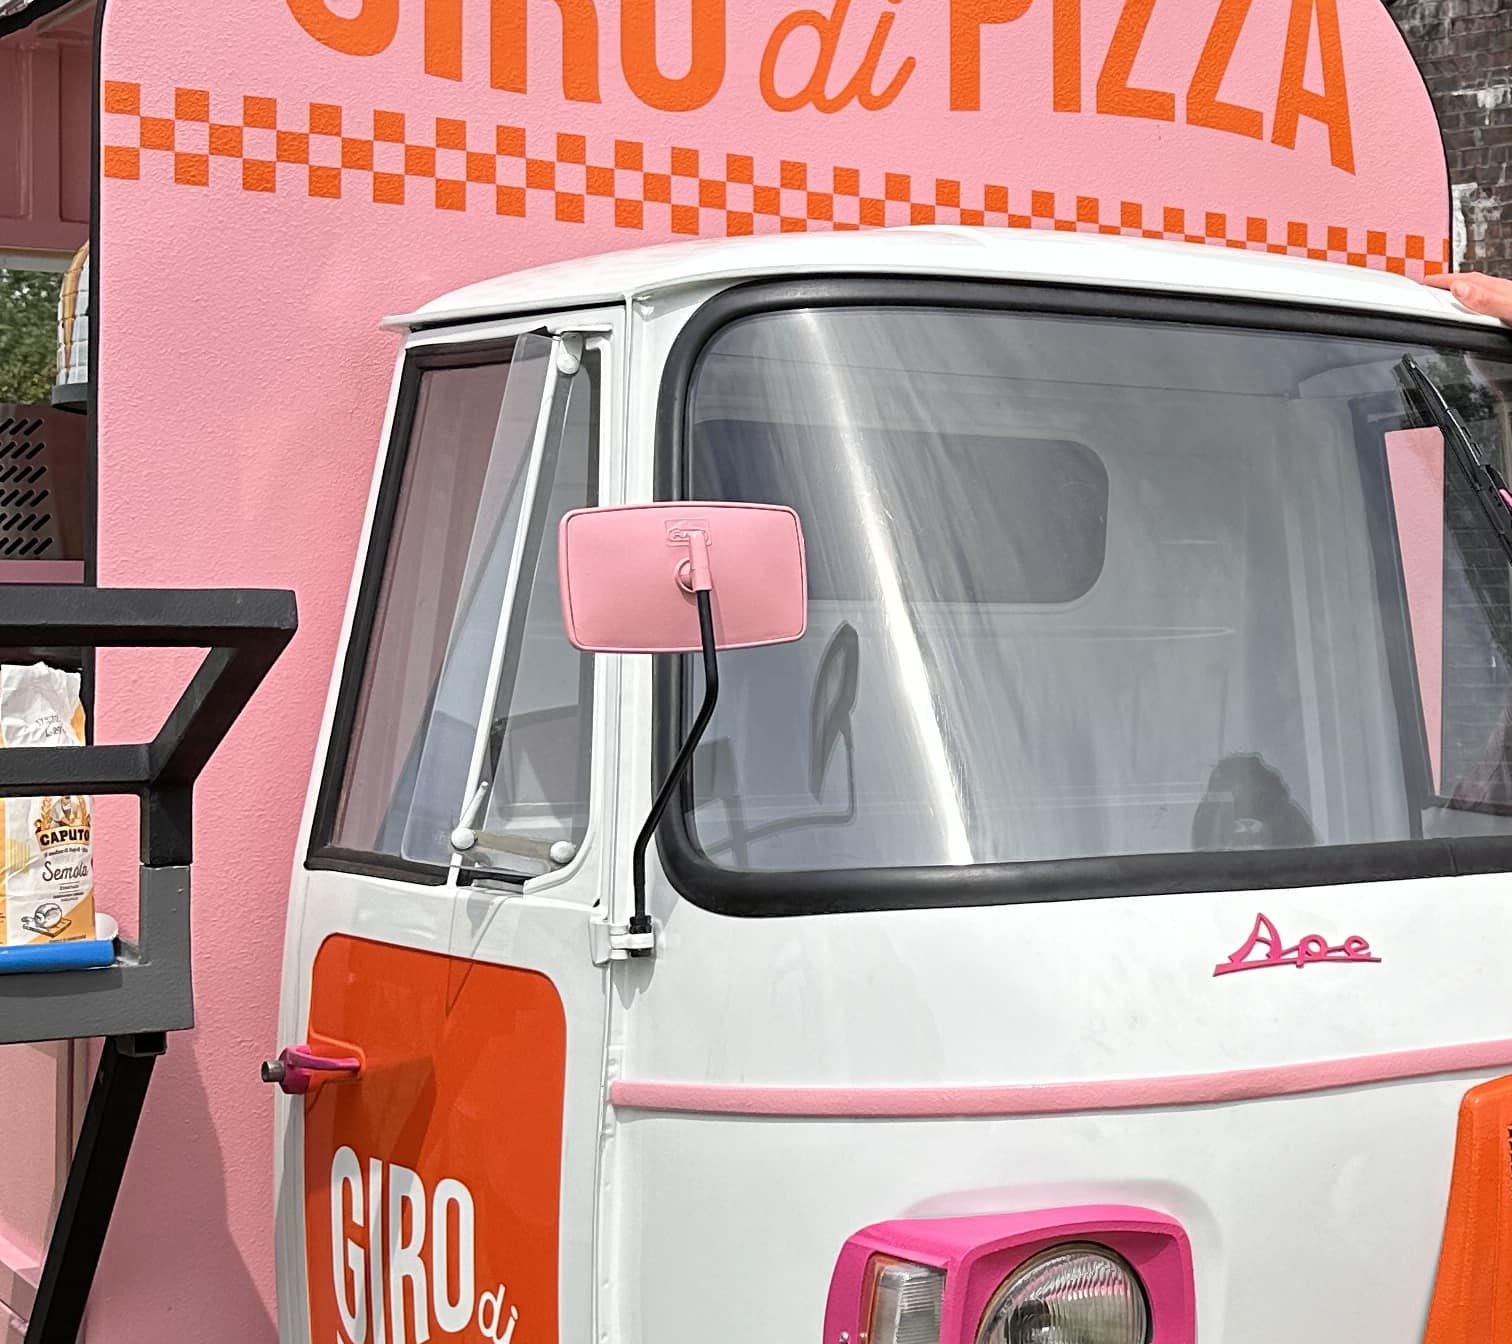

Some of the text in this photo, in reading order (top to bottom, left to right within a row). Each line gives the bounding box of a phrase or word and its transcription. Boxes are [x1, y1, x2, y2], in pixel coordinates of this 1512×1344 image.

[40, 828, 90, 846] CAPUTO
[42, 860, 89, 882] Semola
[1213, 912, 1382, 976] Ape
